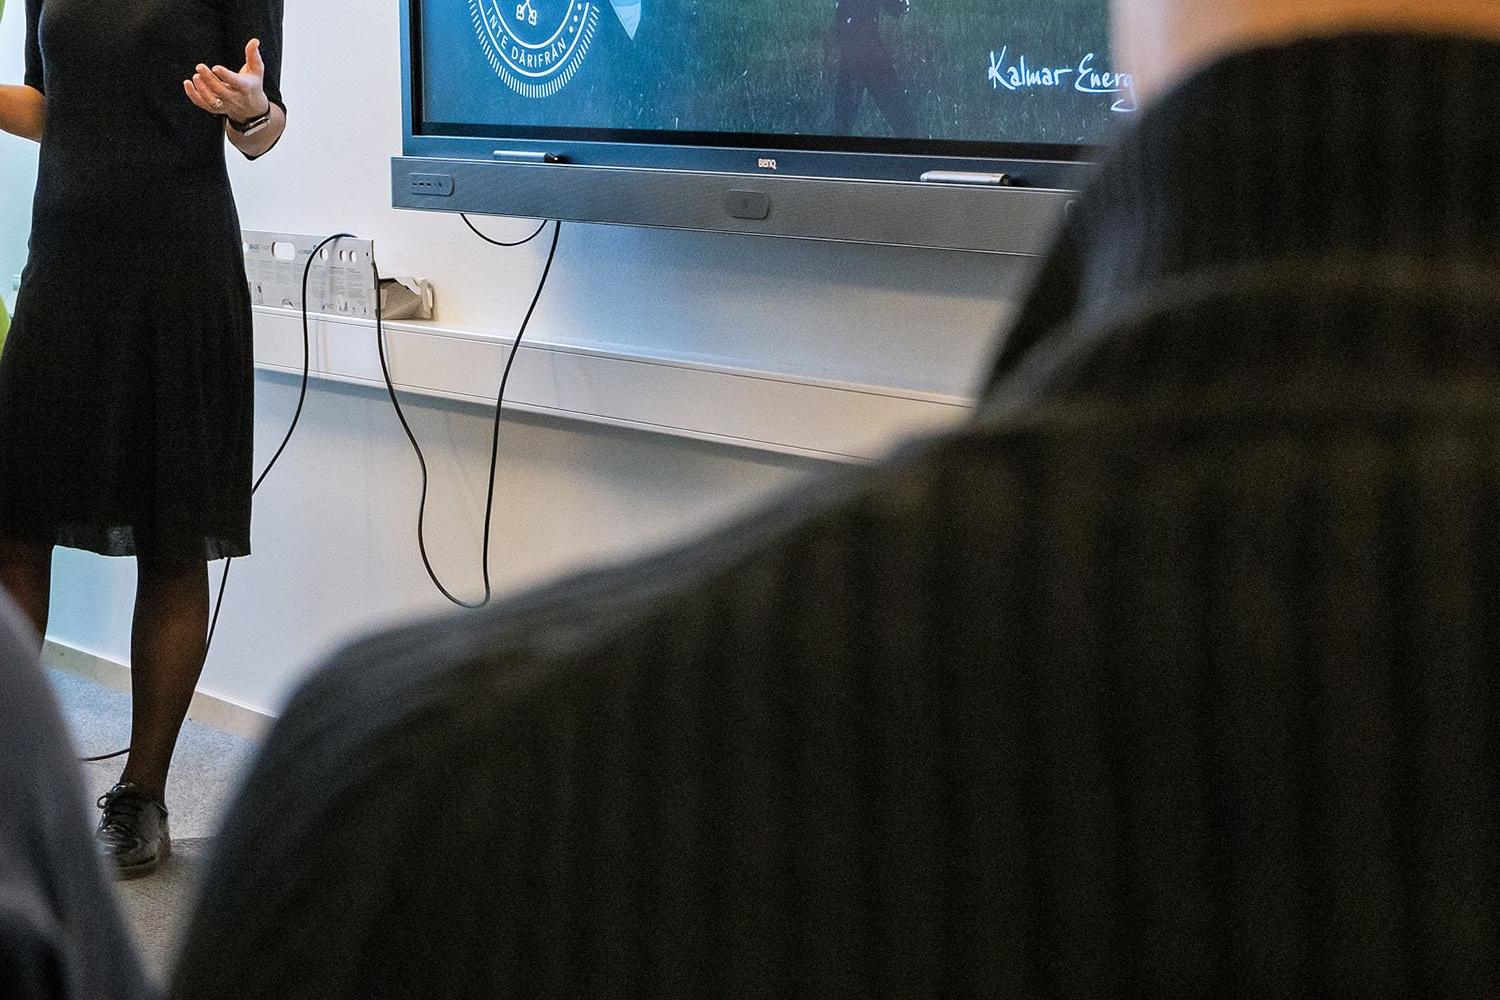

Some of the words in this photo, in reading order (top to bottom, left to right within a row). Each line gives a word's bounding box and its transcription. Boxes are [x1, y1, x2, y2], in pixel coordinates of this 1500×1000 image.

[486, 7, 508, 49] INTE
[511, 39, 567, 68] DÄRIFRÅN
[988, 46, 1072, 90] Kalmar
[1075, 53, 1137, 112] Energ
